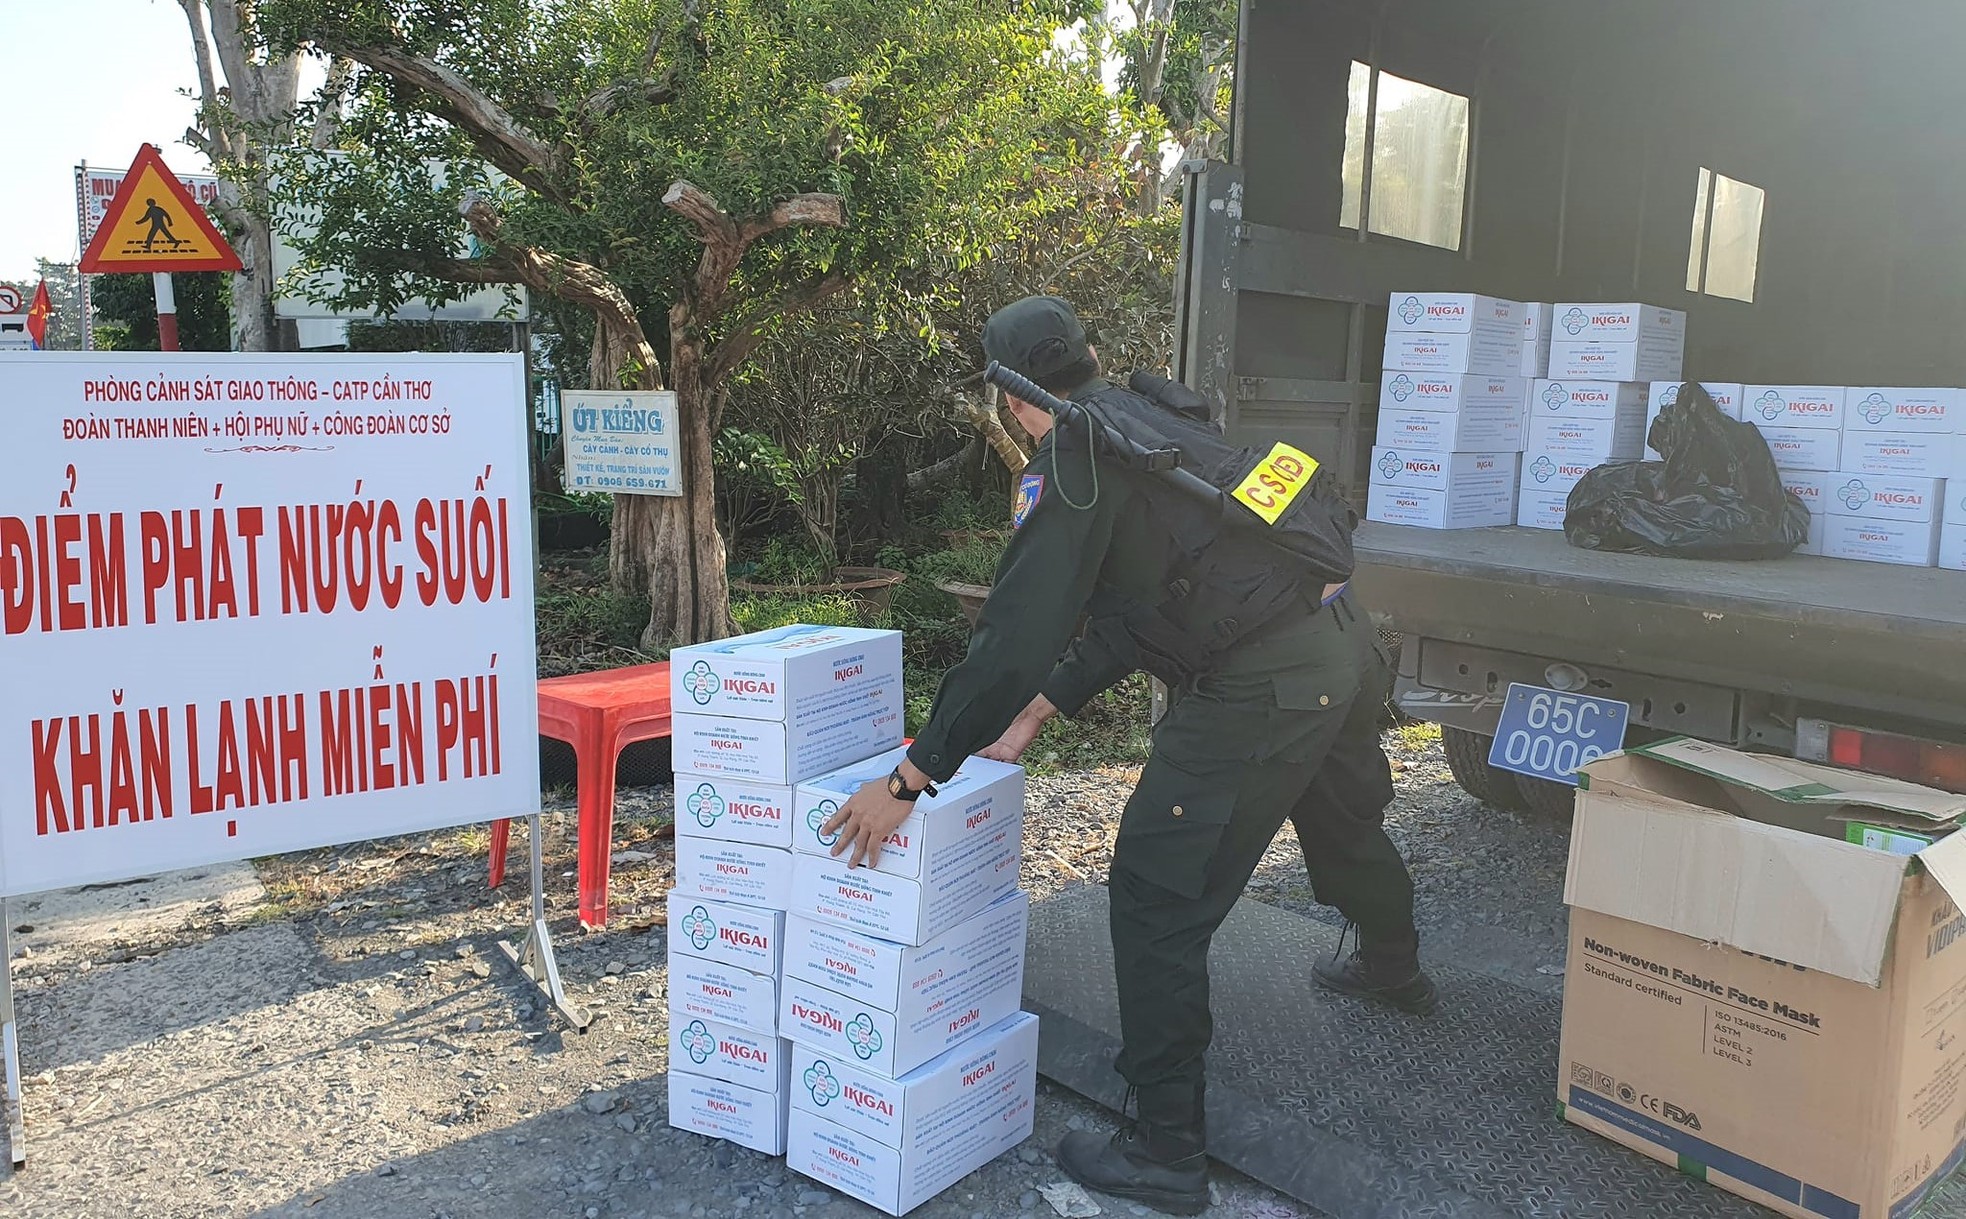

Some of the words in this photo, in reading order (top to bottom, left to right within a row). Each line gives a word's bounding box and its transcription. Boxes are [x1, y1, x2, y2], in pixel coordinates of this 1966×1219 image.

[1427, 306, 1465, 317] IKIGAI
[1592, 316, 1630, 326] IKIGAI
[84, 374, 142, 401] PHÒNG
[146, 372, 190, 401] CẢNH
[194, 374, 223, 401] SÁT
[228, 380, 263, 401] GIAO
[267, 375, 318, 401] THÔNG
[332, 381, 369, 400] CATP
[373, 372, 400, 400] CẦN
[403, 380, 432, 400] THƠ
[1417, 384, 1452, 394] IKIGAI
[1571, 393, 1609, 403] IKIGAI
[1789, 403, 1833, 414] IKIGAI
[1895, 405, 1945, 416] IKIGAI
[63, 412, 110, 439] ĐOÀN
[114, 418, 168, 439] THANH
[173, 411, 208, 437] NIÊN
[212, 422, 220, 436] +
[225, 410, 250, 442] HỘI
[254, 416, 283, 441] PHỤ
[288, 411, 309, 435] NỮ
[312, 422, 320, 436] +
[323, 410, 363, 435] CÔNG
[366, 409, 405, 435] ĐOÀN
[409, 415, 429, 434] CƠ
[432, 407, 451, 434] SỞ
[653, 447, 669, 459] THỤ
[1774, 442, 1801, 450] IKIGAI
[1405, 462, 1440, 472] IKIGAI
[1874, 492, 1922, 505] IKIGAI
[1859, 534, 1888, 542] IKIGAI
[0, 463, 128, 635] ĐIỂM
[140, 483, 264, 625] PHÁT
[277, 479, 403, 615] NƯỚC
[414, 464, 510, 607] SUỐI
[834, 664, 863, 681] IKIGAI
[723, 678, 775, 695] IKIGAI
[1527, 693, 1600, 739] 65C
[31, 689, 173, 836] KHĂN
[185, 693, 308, 837] LẠNH
[319, 645, 424, 797] MIỄN
[434, 653, 501, 782] PHÍ
[711, 739, 742, 750] IKIGAI
[728, 802, 781, 819] IKIGAI
[966, 808, 991, 829] IKIGAI
[716, 863, 748, 875] IKIGAI
[838, 886, 873, 902] IKIGAI
[719, 927, 768, 949] IKIGAI
[825, 957, 857, 975] IKIGAI
[702, 984, 732, 998] IKIGAI
[1584, 937, 1669, 977] Non-woven
[1672, 967, 1724, 995] Fabric
[1727, 986, 1769, 1011] Face
[1772, 1001, 1820, 1029] Mask
[1584, 962, 1633, 988] Standard
[1635, 982, 1682, 1005] certified
[791, 1003, 843, 1033] IKIGAI
[948, 1008, 980, 1034] IKIGAI
[1715, 1010, 1732, 1022] ISO
[1734, 1016, 1787, 1041] 13485:2016
[1714, 1023, 1741, 1038] ASTM
[719, 1041, 767, 1064] IKIGAI
[1713, 1034, 1744, 1052] LEVEL
[1746, 1047, 1753, 1055] 2
[1713, 1046, 1744, 1065] LEVEL
[1746, 1059, 1752, 1067] 3
[962, 1060, 995, 1087] IKIGAI
[707, 1099, 737, 1114] IKIGAI
[843, 1085, 894, 1117] IKIGAI
[1663, 1101, 1702, 1131] FDA
[828, 1146, 859, 1167] IKIGAI
